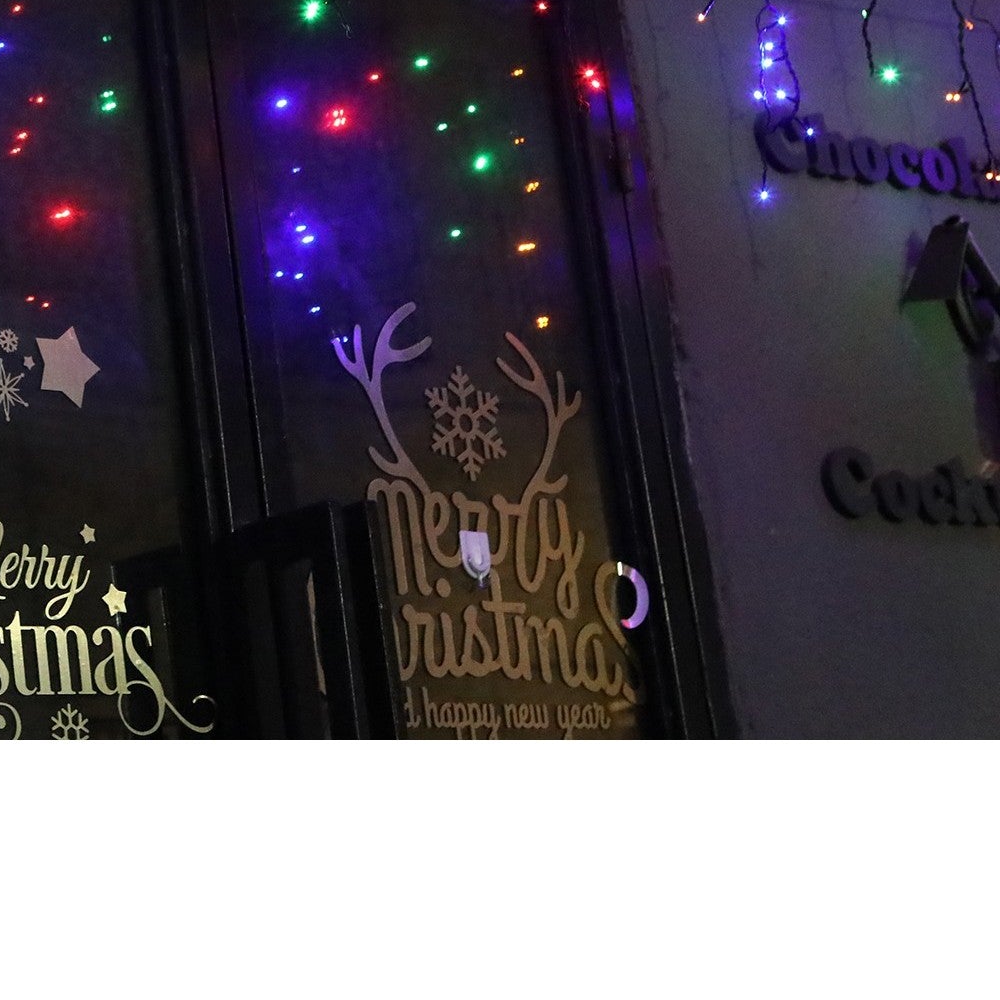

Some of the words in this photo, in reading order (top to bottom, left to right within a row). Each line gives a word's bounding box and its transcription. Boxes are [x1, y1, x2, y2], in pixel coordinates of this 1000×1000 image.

[820, 446, 1000, 527] Cock
[394, 561, 648, 713] ristmas
[421, 686, 499, 739] happy
[504, 702, 549, 730] new
[557, 701, 612, 739] year
